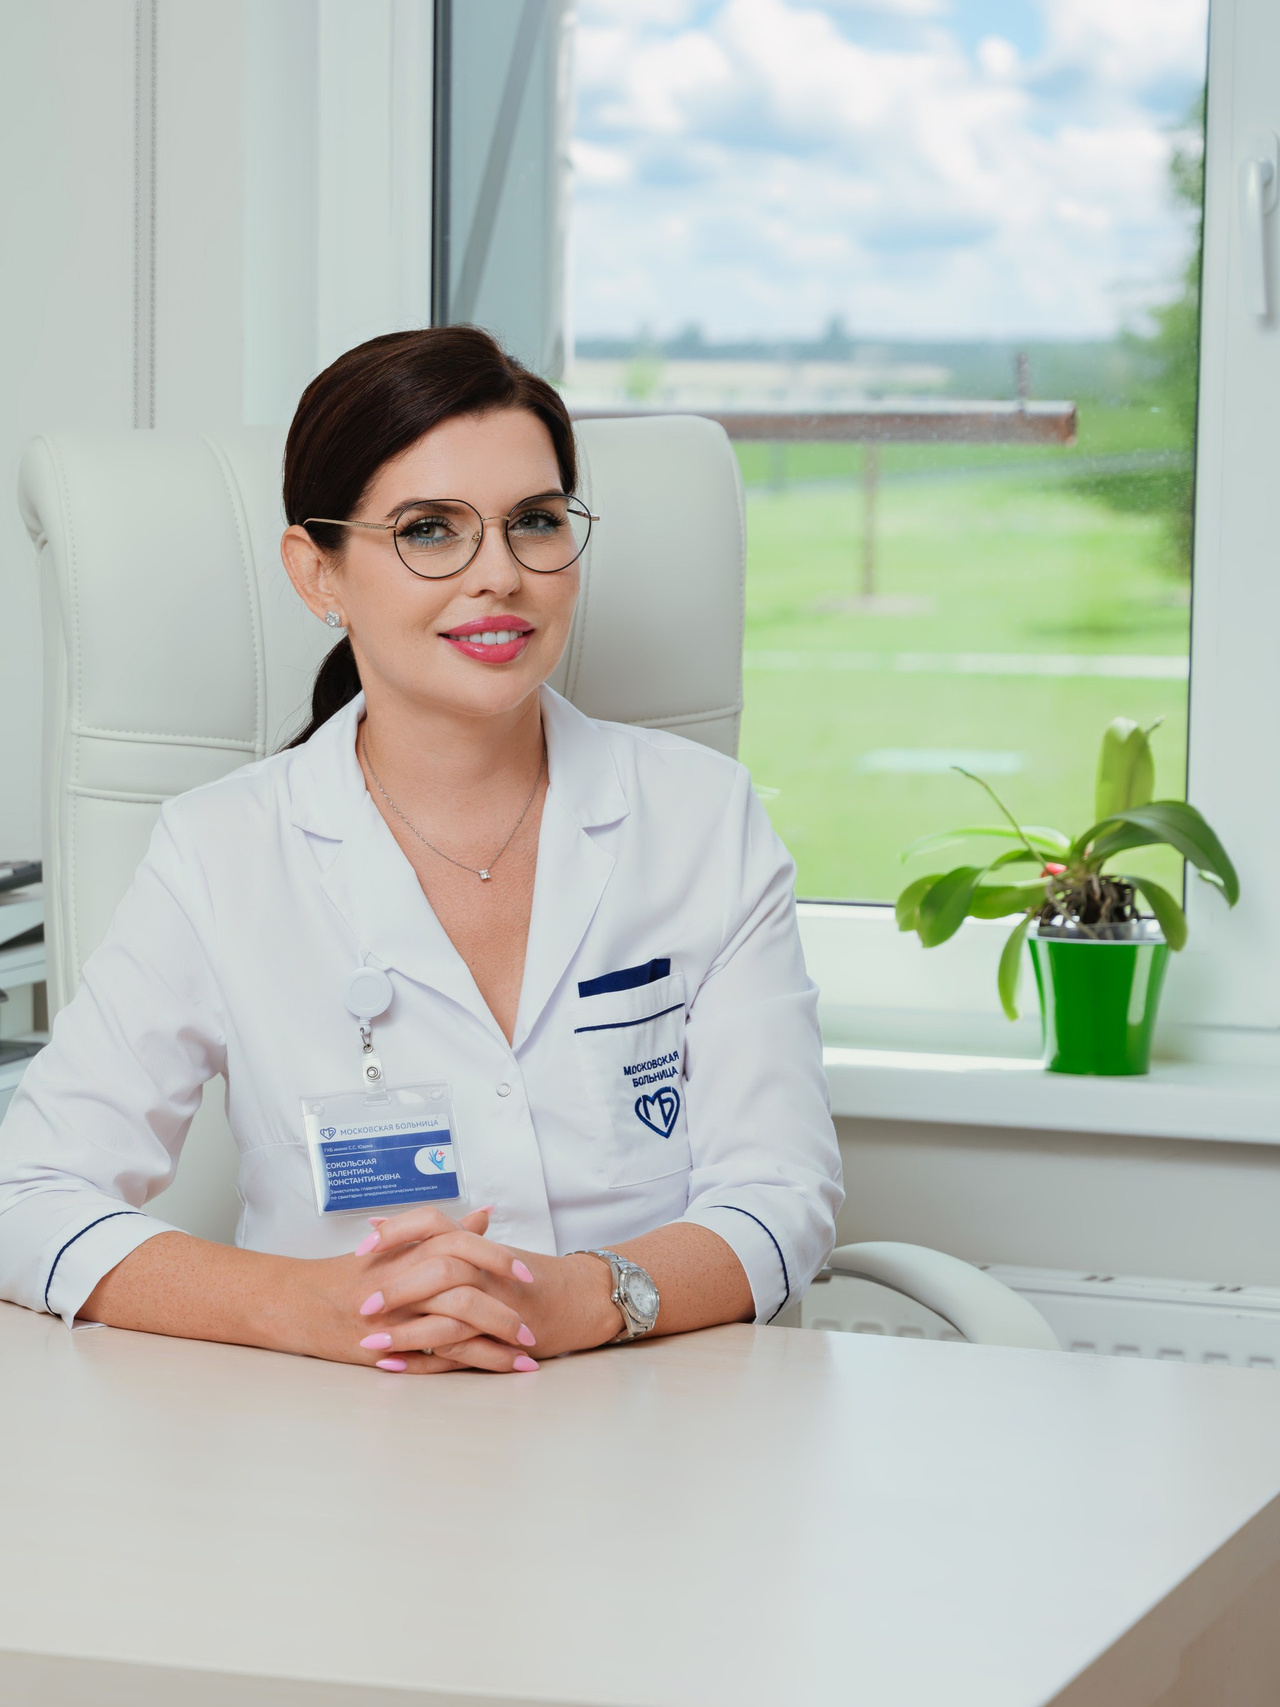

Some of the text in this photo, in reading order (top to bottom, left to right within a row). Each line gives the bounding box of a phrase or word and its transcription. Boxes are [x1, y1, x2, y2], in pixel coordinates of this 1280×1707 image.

[623, 1050, 679, 1076] МОСКОВСКАЯ
[632, 1066, 679, 1088] БОЛЬНИЦА
[340, 1119, 439, 1136] МОСКОВСКАЯ БОЛЬНИЦА
[325, 1158, 377, 1169] СОКОЛЬСКАЯ
[326, 1167, 374, 1178] ВАЛЕНТИНА
[328, 1173, 401, 1187] КОНСТАНТИНОВНА
